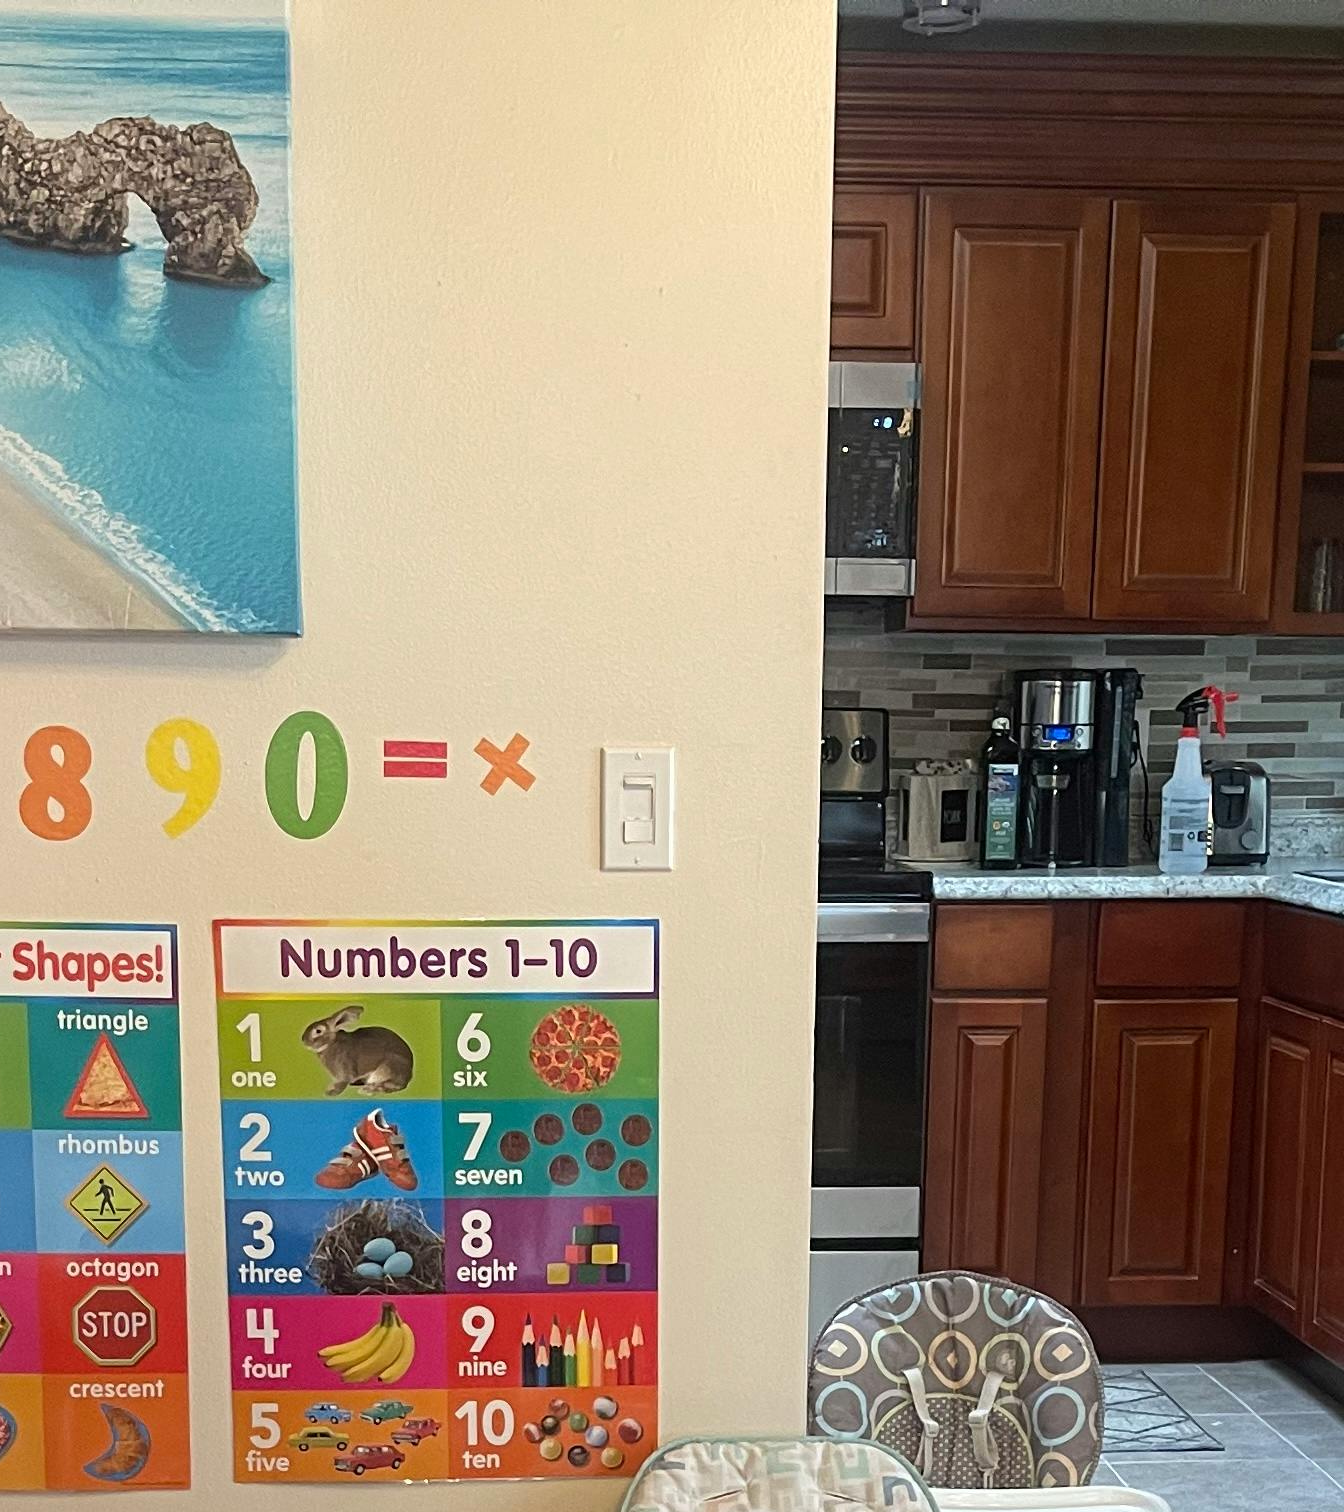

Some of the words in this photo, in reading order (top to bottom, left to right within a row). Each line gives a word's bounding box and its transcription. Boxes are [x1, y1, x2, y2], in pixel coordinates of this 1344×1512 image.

[18, 725, 93, 841] 8
[145, 718, 222, 839] 9
[265, 711, 348, 840] 0
[12, 941, 164, 991] Shapes!
[280, 936, 488, 979] Numbers
[57, 1009, 148, 1036] triangle
[236, 1013, 261, 1062] 1
[457, 1013, 491, 1062] 6
[231, 1069, 276, 1088] one
[453, 1065, 488, 1088] six
[57, 1133, 159, 1155] rhombus
[238, 1113, 272, 1162] 2
[458, 1113, 492, 1161] 7
[235, 1167, 285, 1186] two
[455, 1168, 523, 1186] seven
[242, 1211, 275, 1260] 3
[460, 1210, 492, 1258] 8
[66, 1260, 159, 1279] octagon
[238, 1263, 302, 1284] three
[457, 1261, 517, 1288] eight
[81, 1313, 147, 1338] STOP
[246, 1308, 279, 1354] 4
[462, 1305, 495, 1353] 9
[242, 1355, 292, 1379] four
[458, 1357, 507, 1377] nine
[69, 1381, 164, 1398] crescent
[250, 1403, 280, 1449] 5
[454, 1399, 515, 1446] 10
[245, 1450, 290, 1472] five
[462, 1451, 500, 1469] ten
